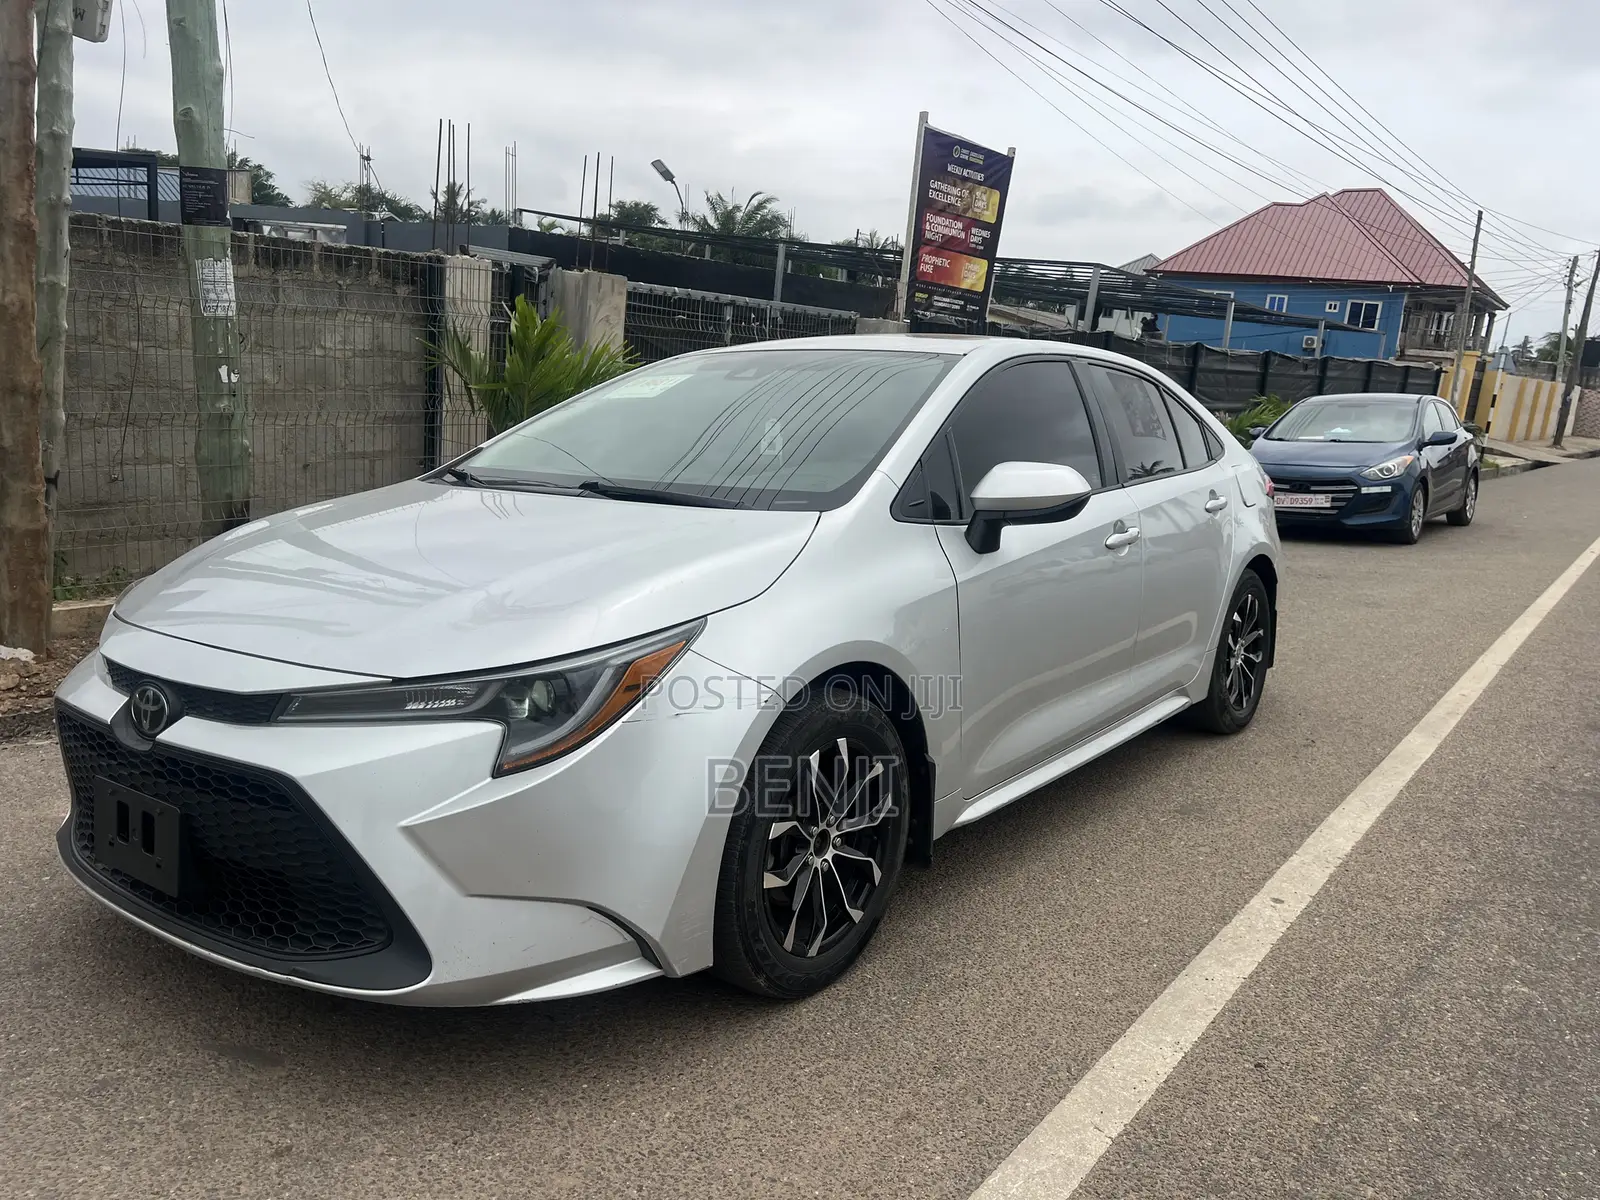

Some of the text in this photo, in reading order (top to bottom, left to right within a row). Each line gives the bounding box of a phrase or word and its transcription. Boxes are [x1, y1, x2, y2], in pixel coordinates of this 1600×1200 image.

[947, 163, 984, 181] WEEKLY ACTIVITIES
[929, 179, 970, 198] GATHERING OF
[928, 189, 962, 207] EXCELLENCE
[926, 213, 963, 230] FOUNDATION
[924, 230, 943, 242] NIGHT
[925, 221, 966, 240] & COMMUNION
[971, 227, 991, 239] WEDNES
[970, 234, 982, 244] DAYS
[919, 263, 934, 274] FUSE
[921, 253, 951, 268] PROPHETIC
